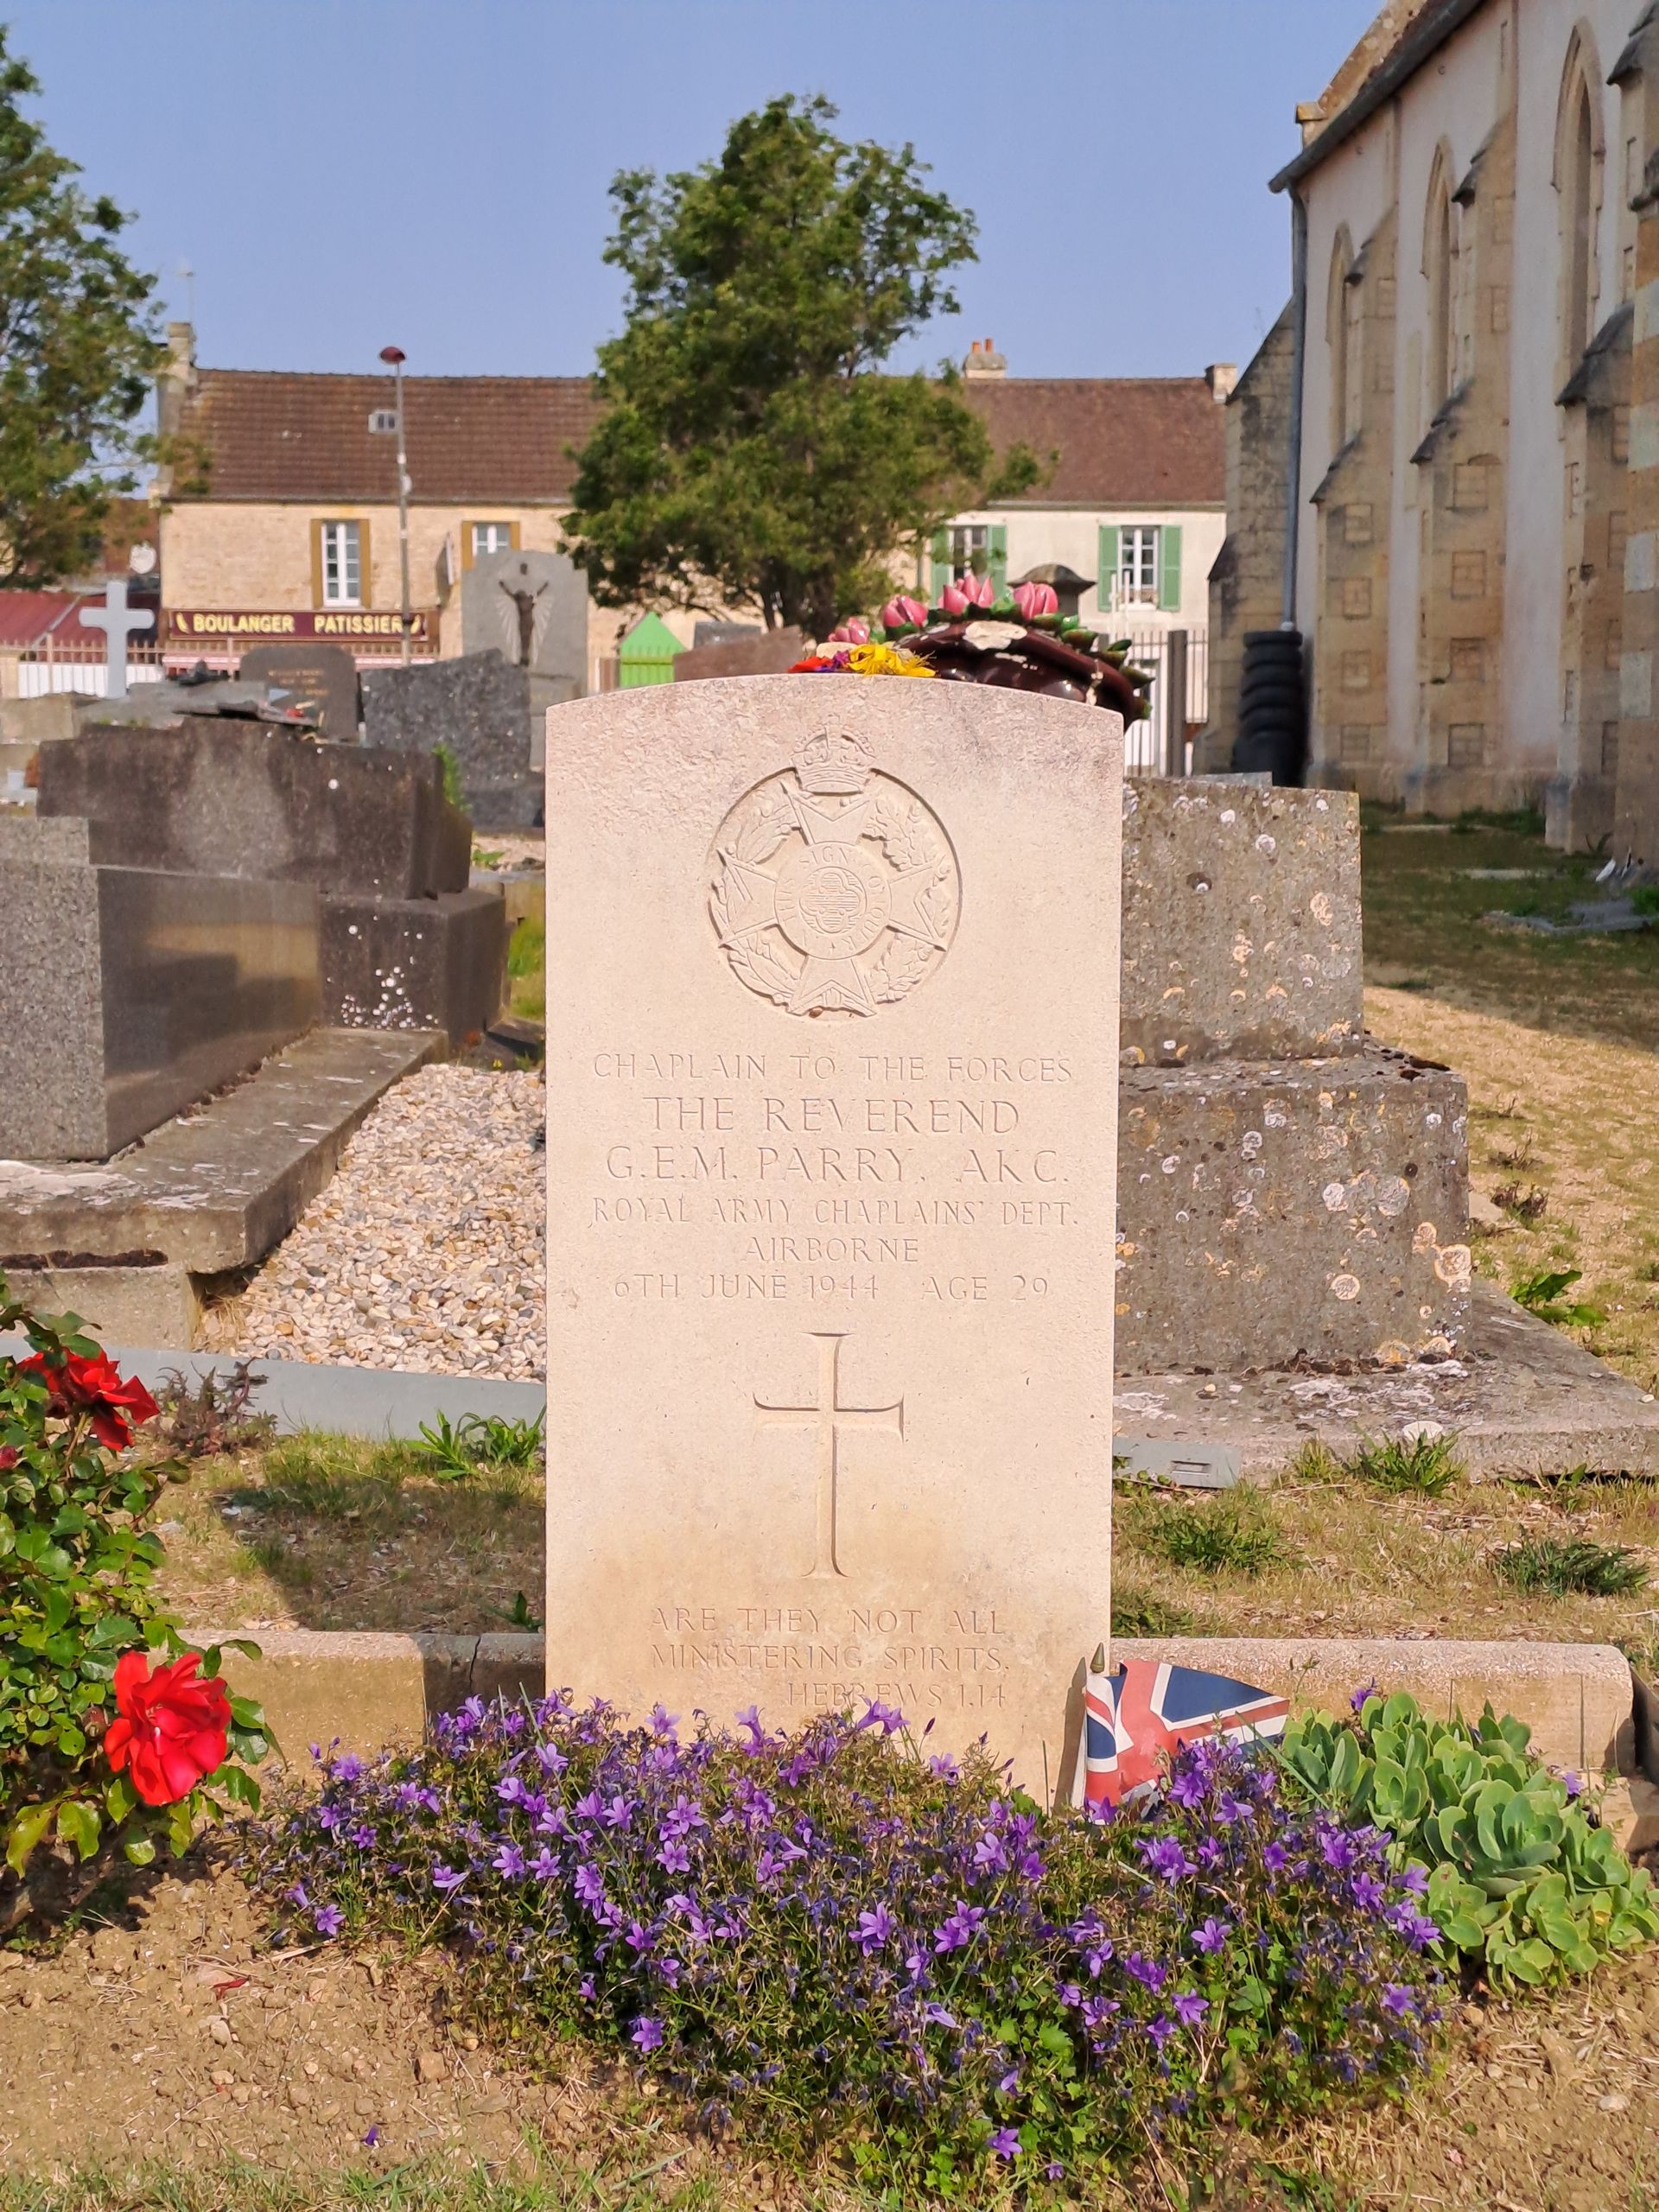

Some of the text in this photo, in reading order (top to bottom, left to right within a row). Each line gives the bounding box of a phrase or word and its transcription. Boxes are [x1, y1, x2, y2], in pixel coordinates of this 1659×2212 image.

[192, 613, 404, 634] BOULANGER PATISSIER
[594, 1053, 1071, 1083] CHAPLAIN TO THE FORCES
[643, 1096, 1020, 1134] THE REVEREND
[607, 1146, 738, 1180] G.E.M.
[594, 1197, 690, 1223] ROYAL
[712, 1198, 795, 1224] ARMY
[1001, 1201, 1078, 1225] DEPT.
[742, 1236, 918, 1262] AIRBORNE
[614, 1274, 1048, 1301] 6TH JUNE 1944 AGE 29
[649, 1607, 1006, 1635] ARE THEY NOT ALL
[652, 1643, 1010, 1672] MINISTERING SPIRITS.
[787, 1682, 1007, 1708] HEBREWS 1.14
